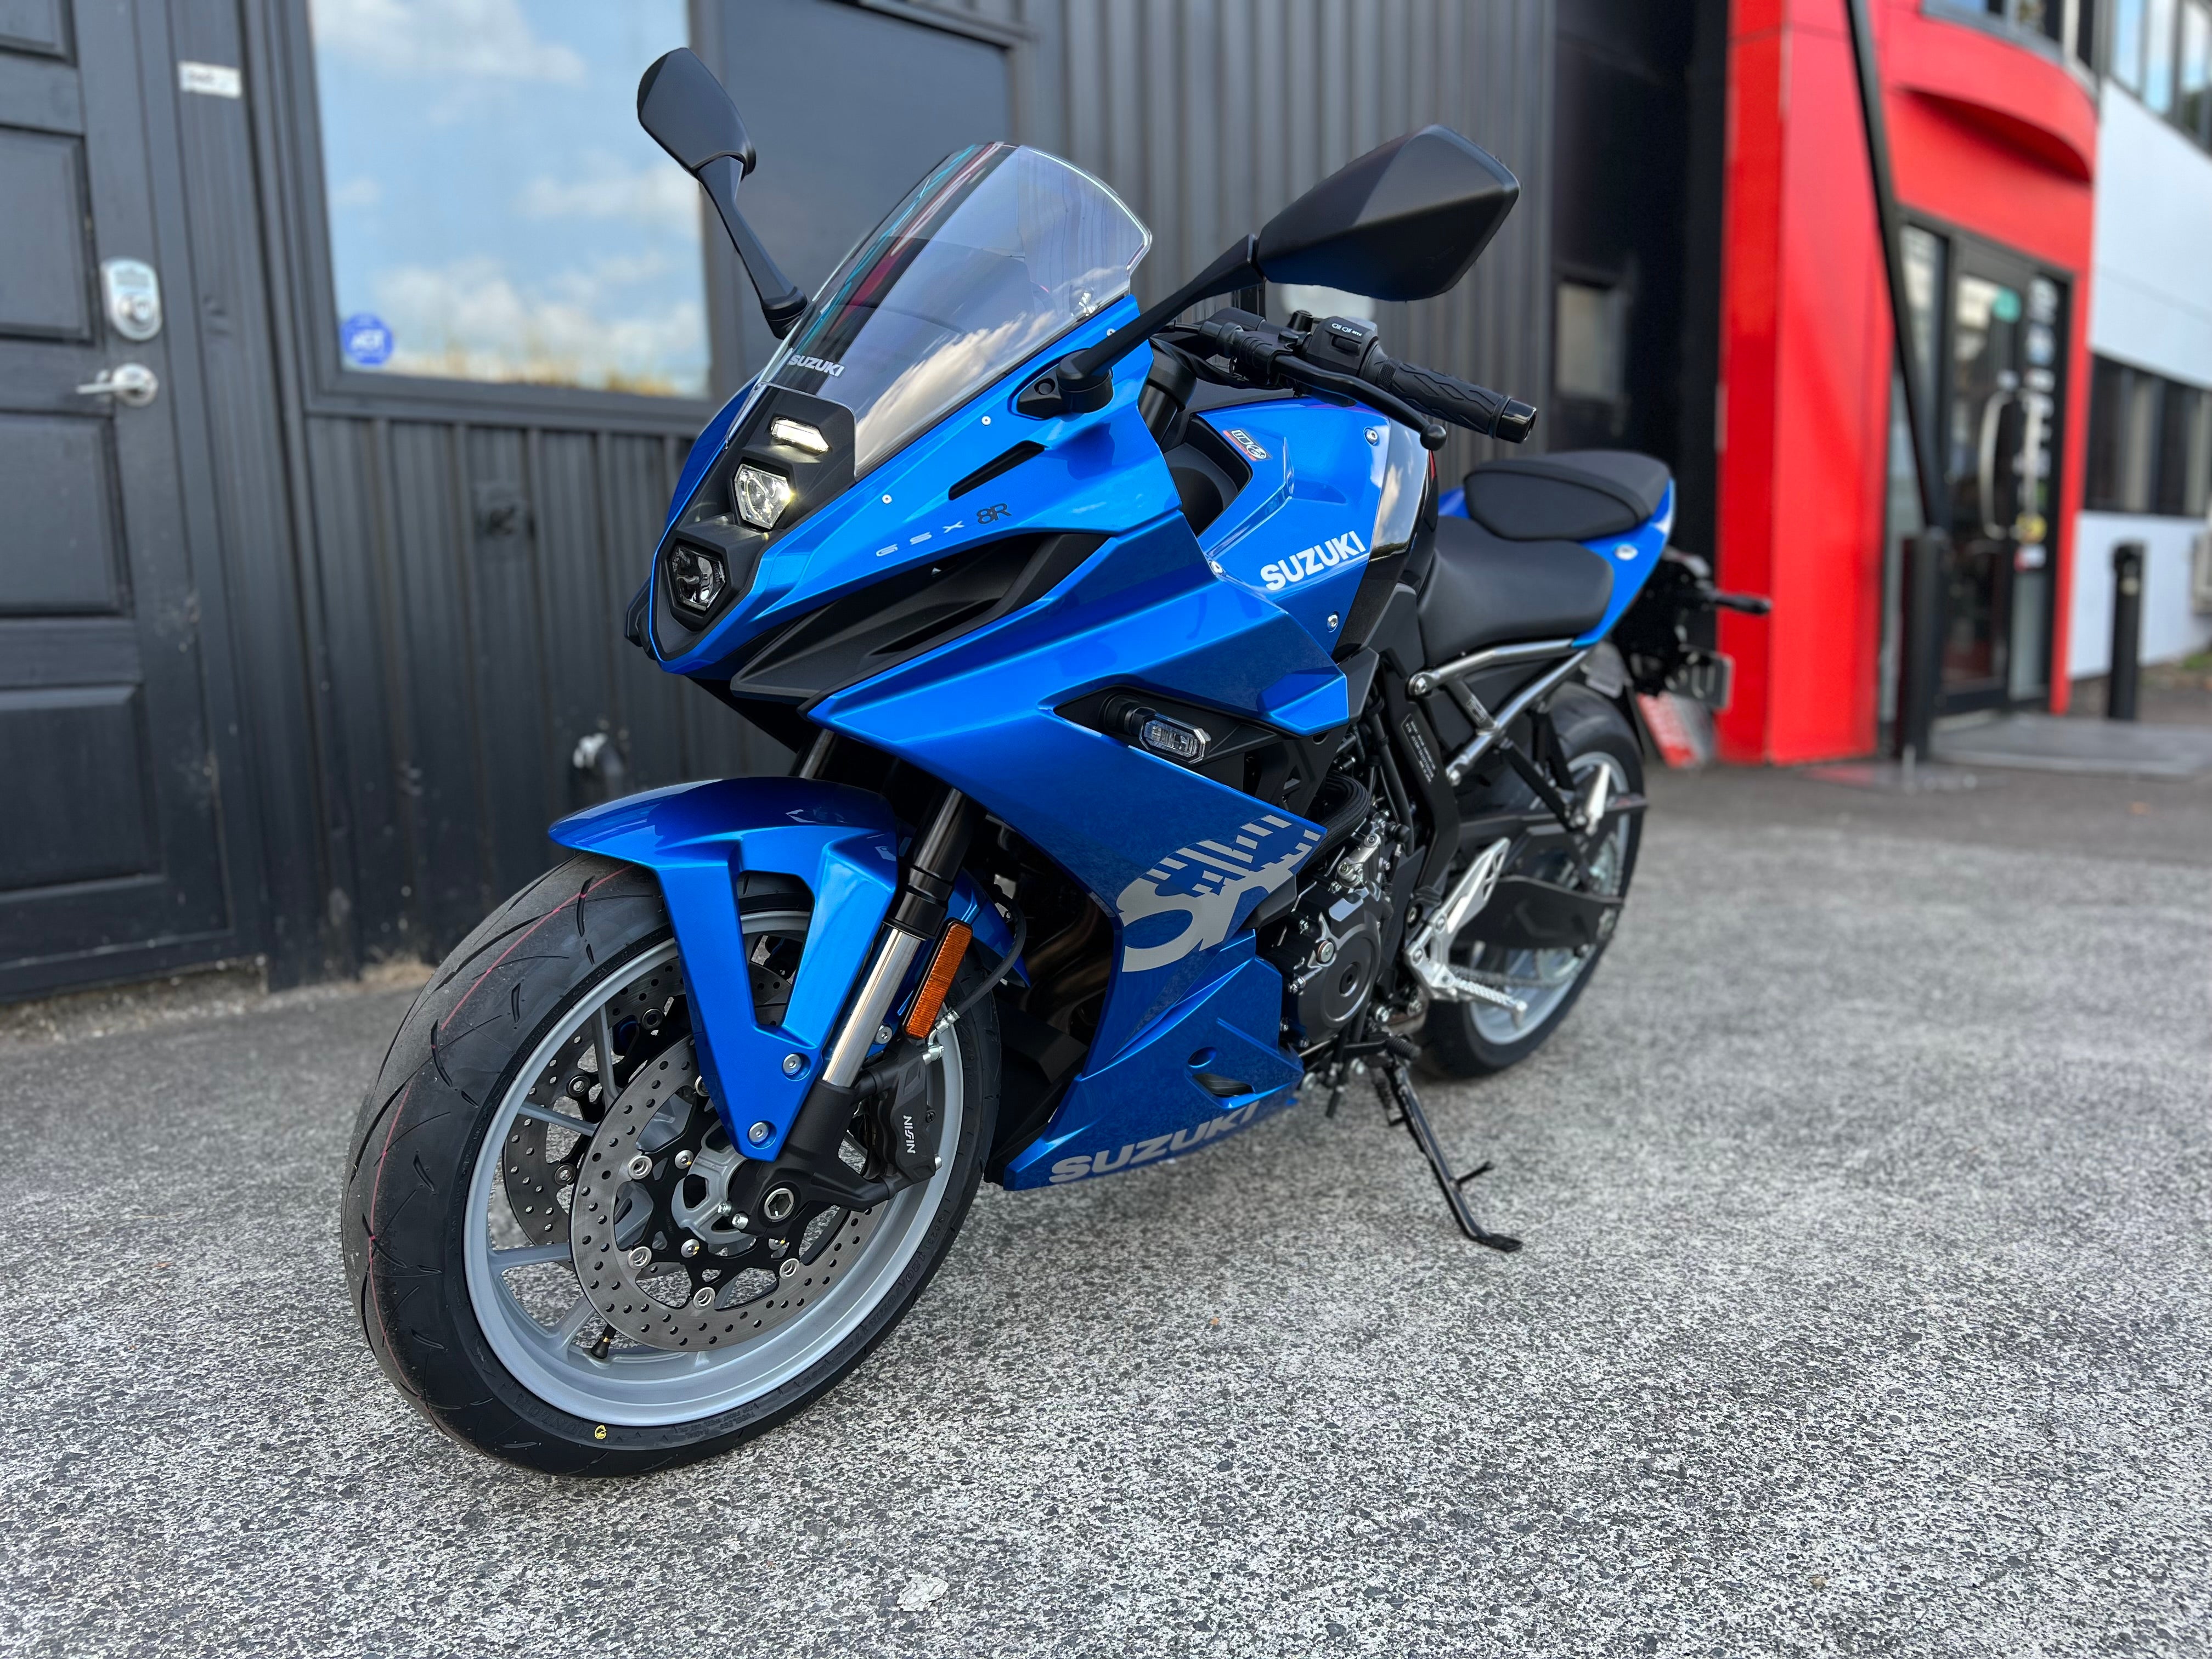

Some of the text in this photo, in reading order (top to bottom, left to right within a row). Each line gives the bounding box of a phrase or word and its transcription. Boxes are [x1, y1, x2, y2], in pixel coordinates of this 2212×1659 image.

[788, 354, 845, 377] SUZUKI
[876, 503, 1012, 557] GSX 8R
[1260, 530, 1367, 591] SUZUKI
[1049, 1101, 1260, 1183] SUZUKI
